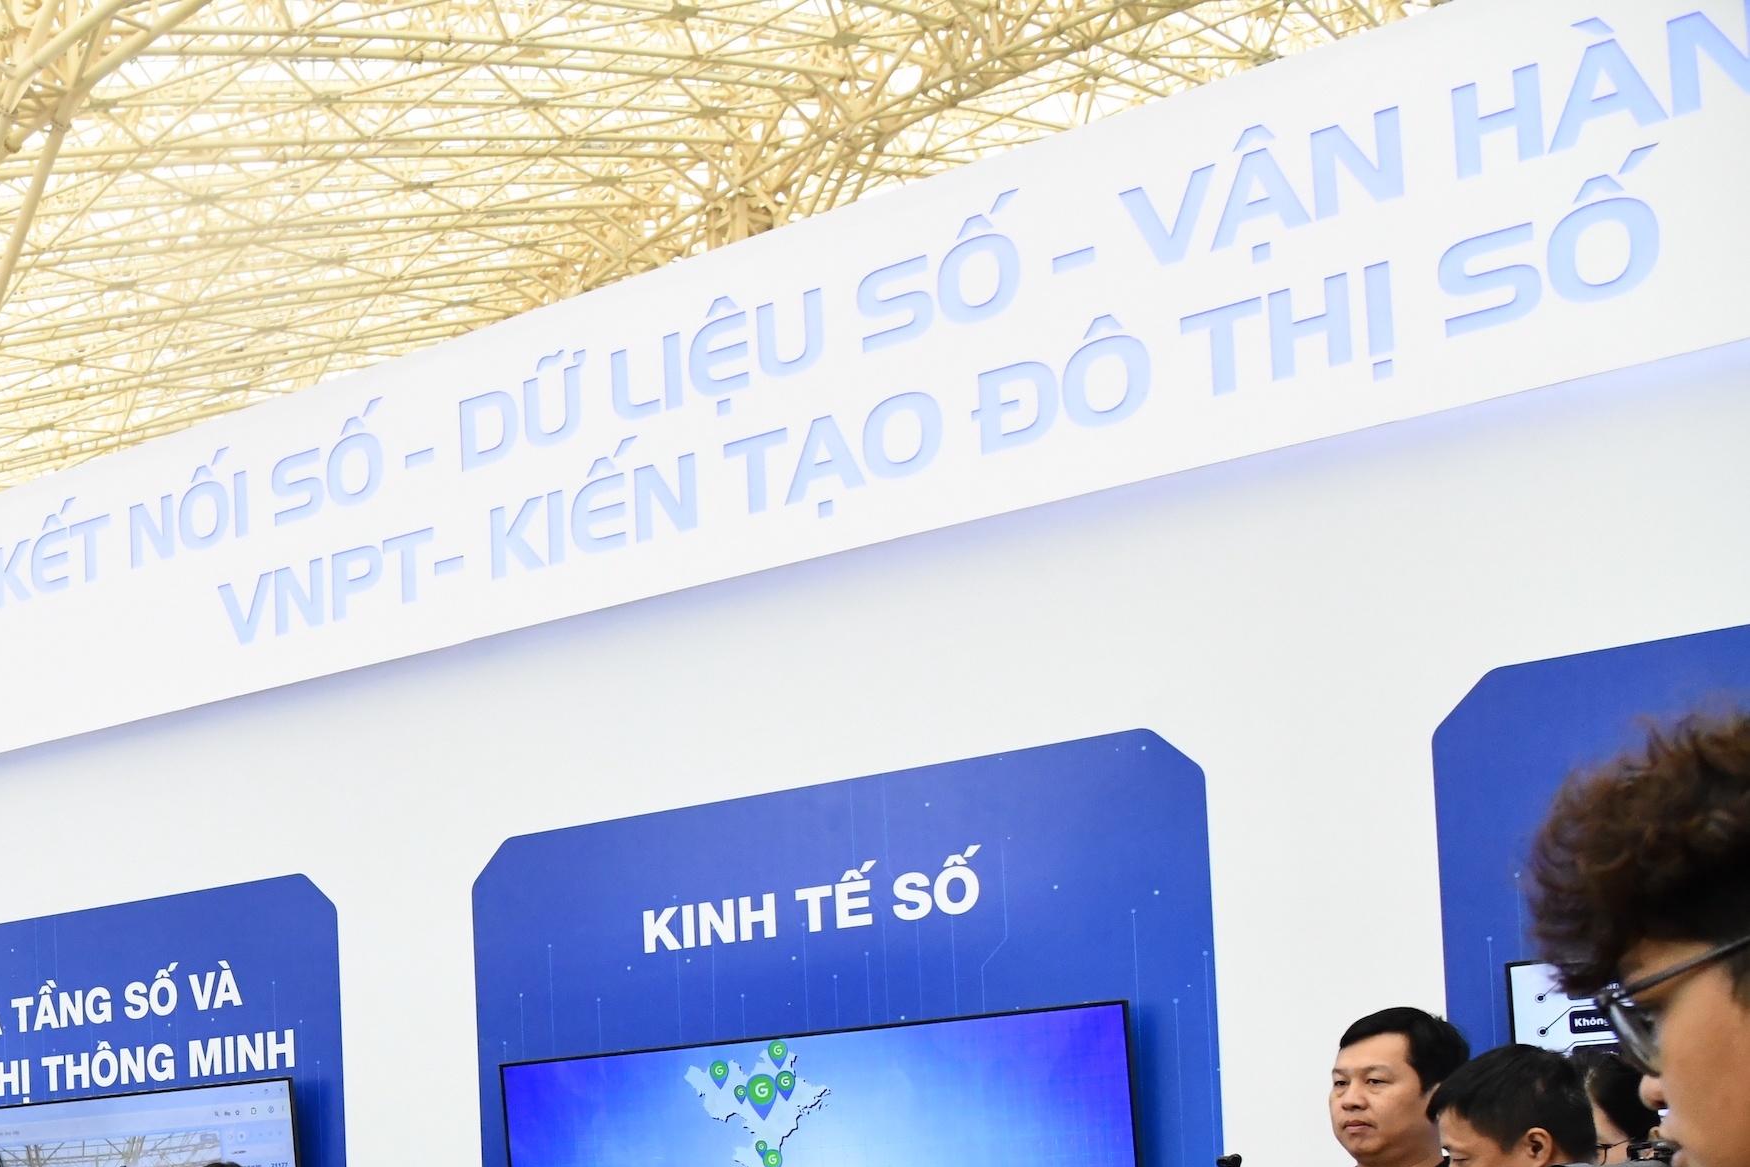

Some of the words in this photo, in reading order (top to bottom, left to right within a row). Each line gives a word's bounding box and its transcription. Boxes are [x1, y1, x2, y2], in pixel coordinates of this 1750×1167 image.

[130, 446, 248, 570] NỐI
[273, 396, 383, 526] SỐ
[460, 350, 586, 472] DỮ
[612, 287, 825, 420] LIỆU
[856, 187, 1020, 354] SỐ
[1119, 124, 1405, 264] VẬN
[490, 436, 698, 580] KIẾN
[723, 390, 942, 518] TẠO
[972, 314, 1151, 455] ĐÔ
[1180, 260, 1395, 382] THỊ
[1437, 142, 1660, 338] SỐ
[642, 892, 777, 954] KINH
[795, 859, 877, 933] TẾ
[892, 843, 982, 921] SỐ
[11, 979, 112, 1033] TẦNG
[124, 961, 179, 1021] SỐ
[188, 960, 243, 1012] VÀ
[41, 1041, 175, 1092] THÔNG
[188, 1028, 296, 1078] MINH
